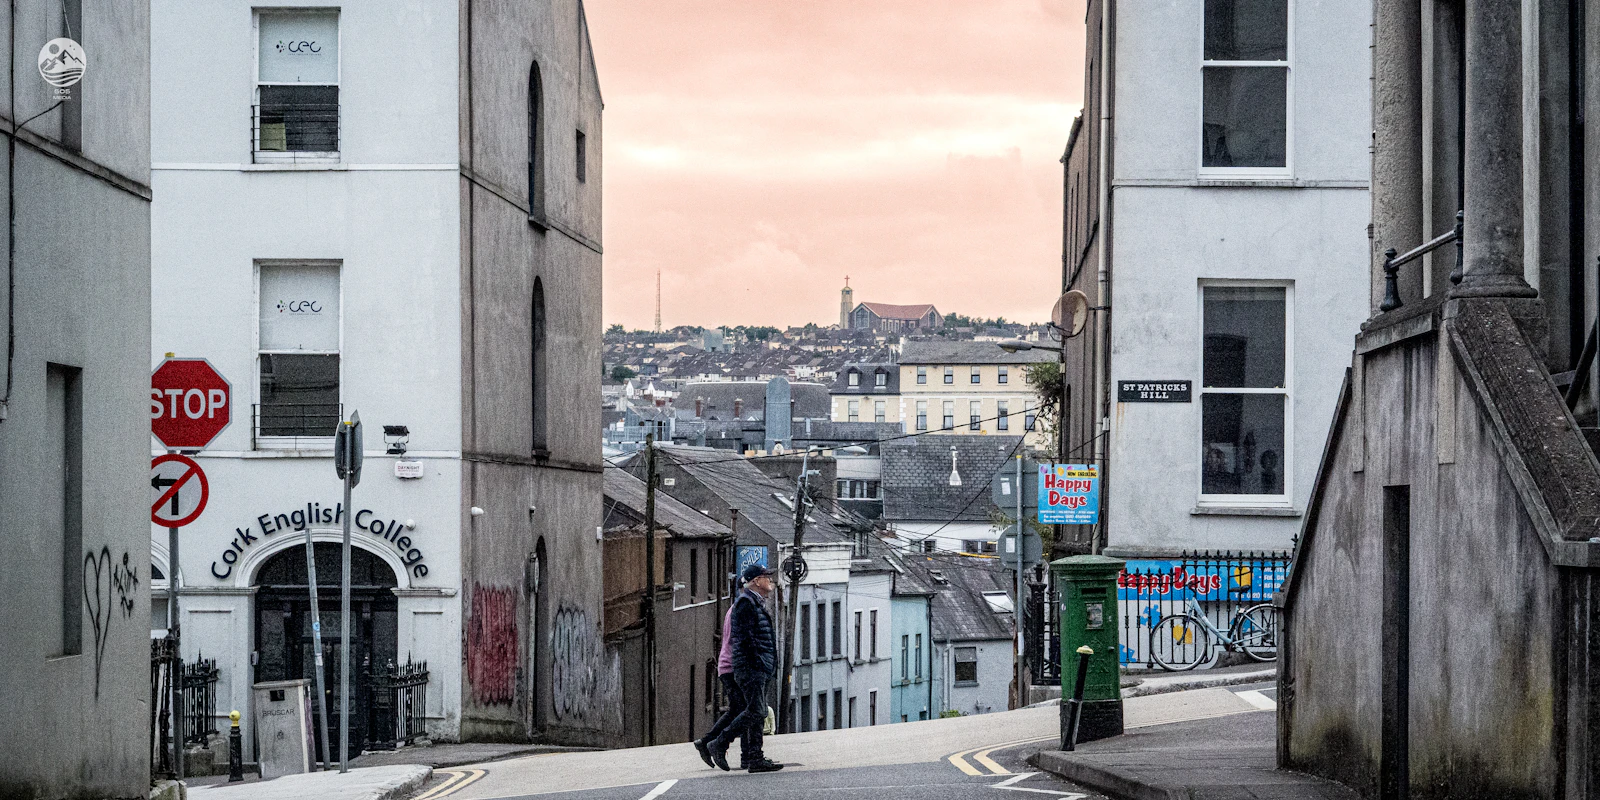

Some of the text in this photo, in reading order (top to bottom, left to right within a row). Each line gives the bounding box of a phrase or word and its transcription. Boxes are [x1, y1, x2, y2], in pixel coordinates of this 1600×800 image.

[1123, 384, 1188, 392] ST PATRICKS
[1140, 391, 1170, 399] HILL
[151, 388, 227, 420] STOP
[1045, 474, 1091, 492] Happy
[1048, 491, 1087, 509] Days
[211, 502, 429, 580] Cork English College
[1173, 566, 1222, 594] Days
